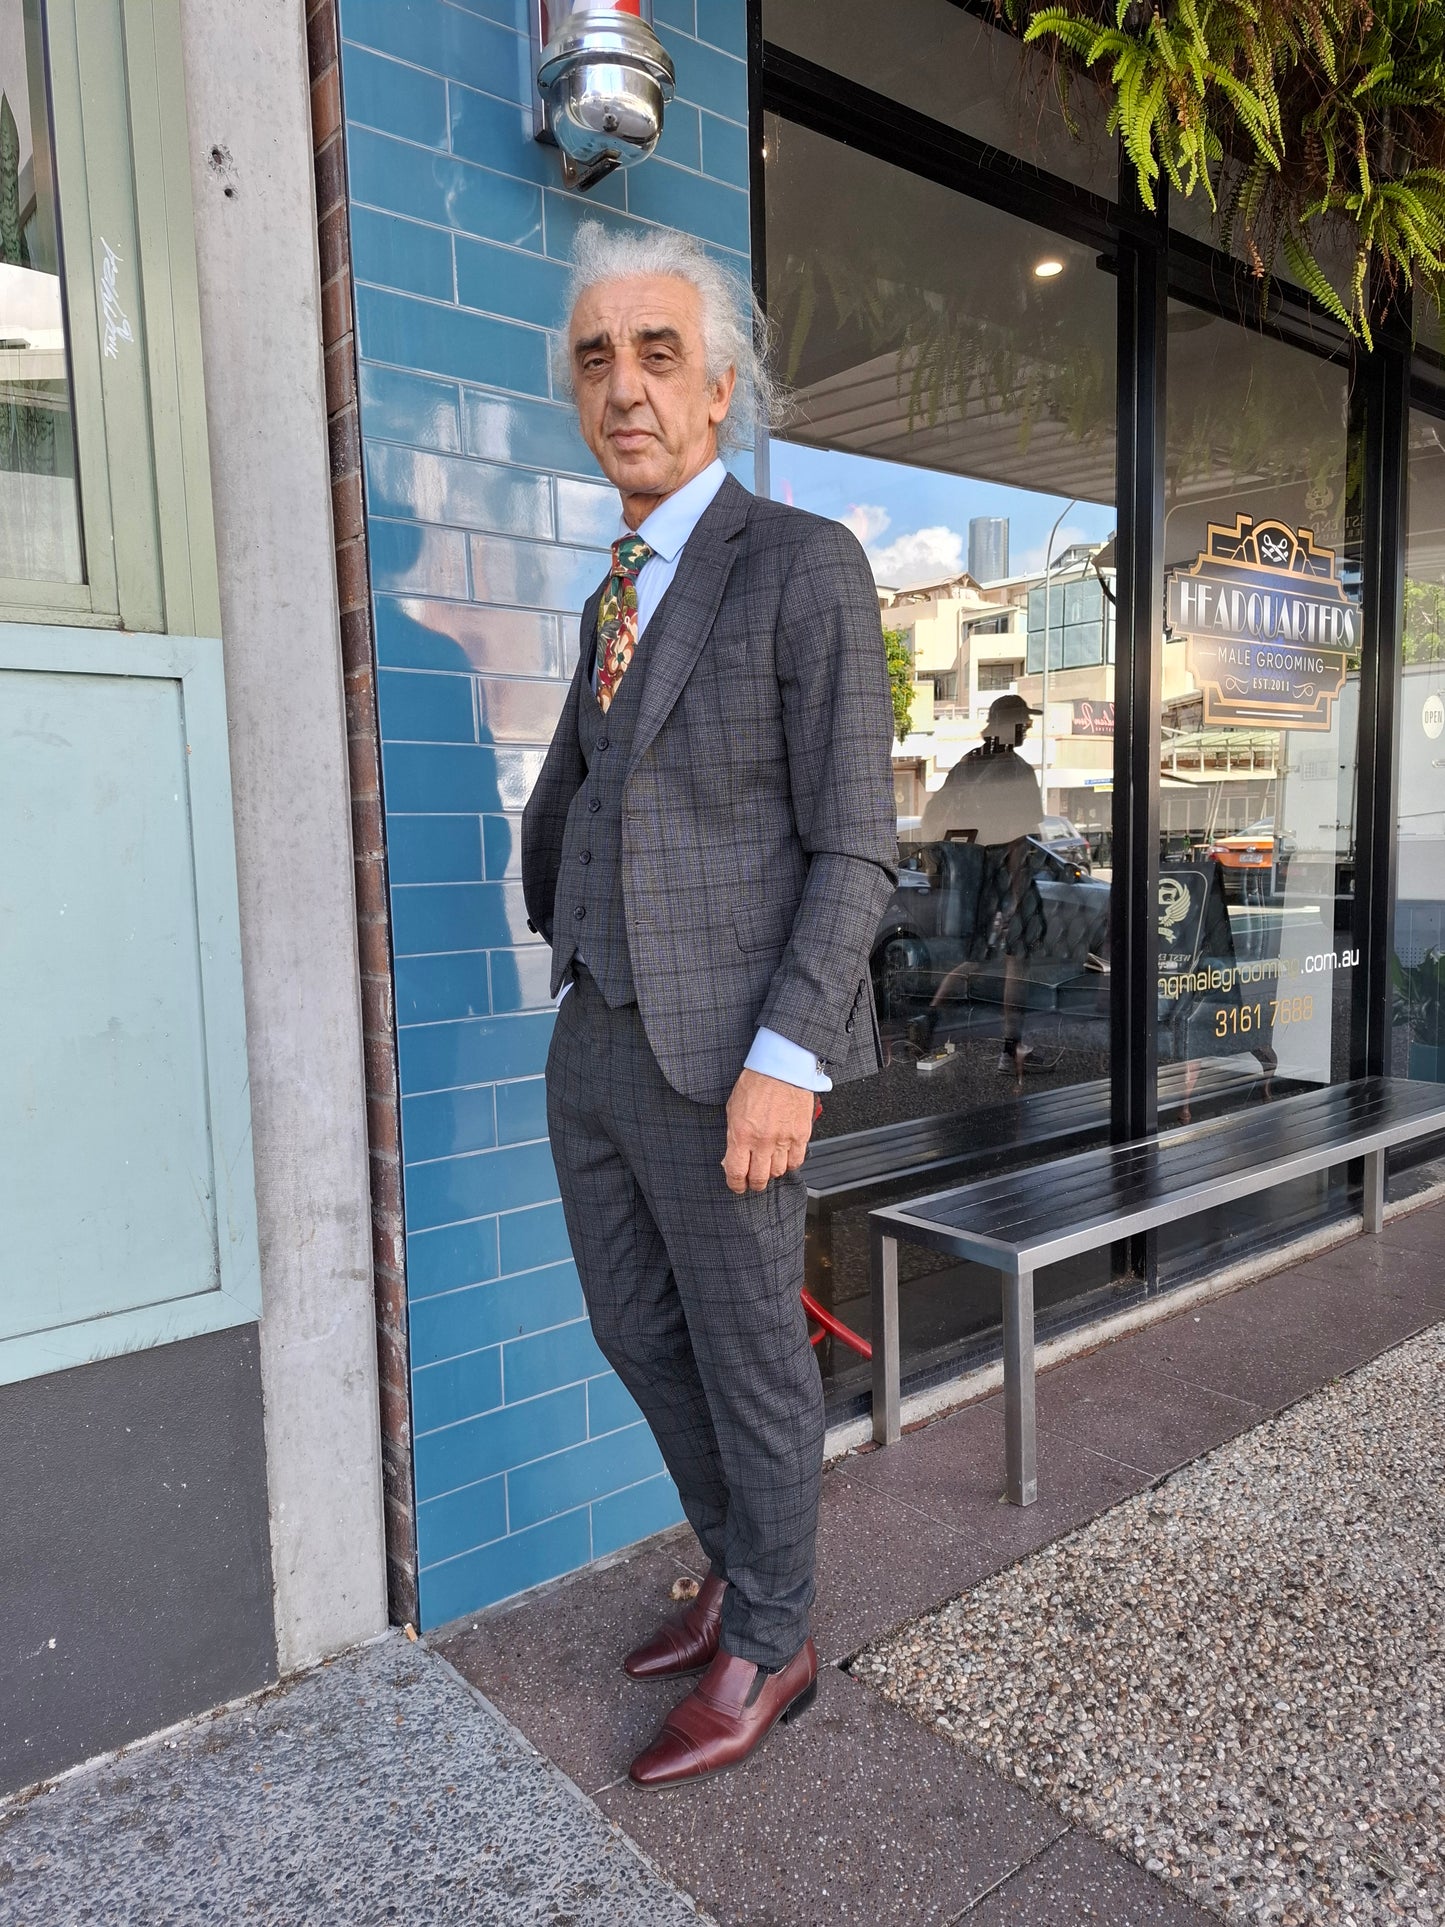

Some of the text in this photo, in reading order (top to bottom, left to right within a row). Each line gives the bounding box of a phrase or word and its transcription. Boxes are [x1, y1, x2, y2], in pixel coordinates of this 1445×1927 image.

[1179, 581, 1355, 648] HEADQUARTERS
[1218, 646, 1324, 674] MALE GROOMING
[1253, 678, 1290, 692] EST.2011
[1424, 710, 1443, 724] OPEN
[1215, 995, 1314, 1038] 3161 7688
